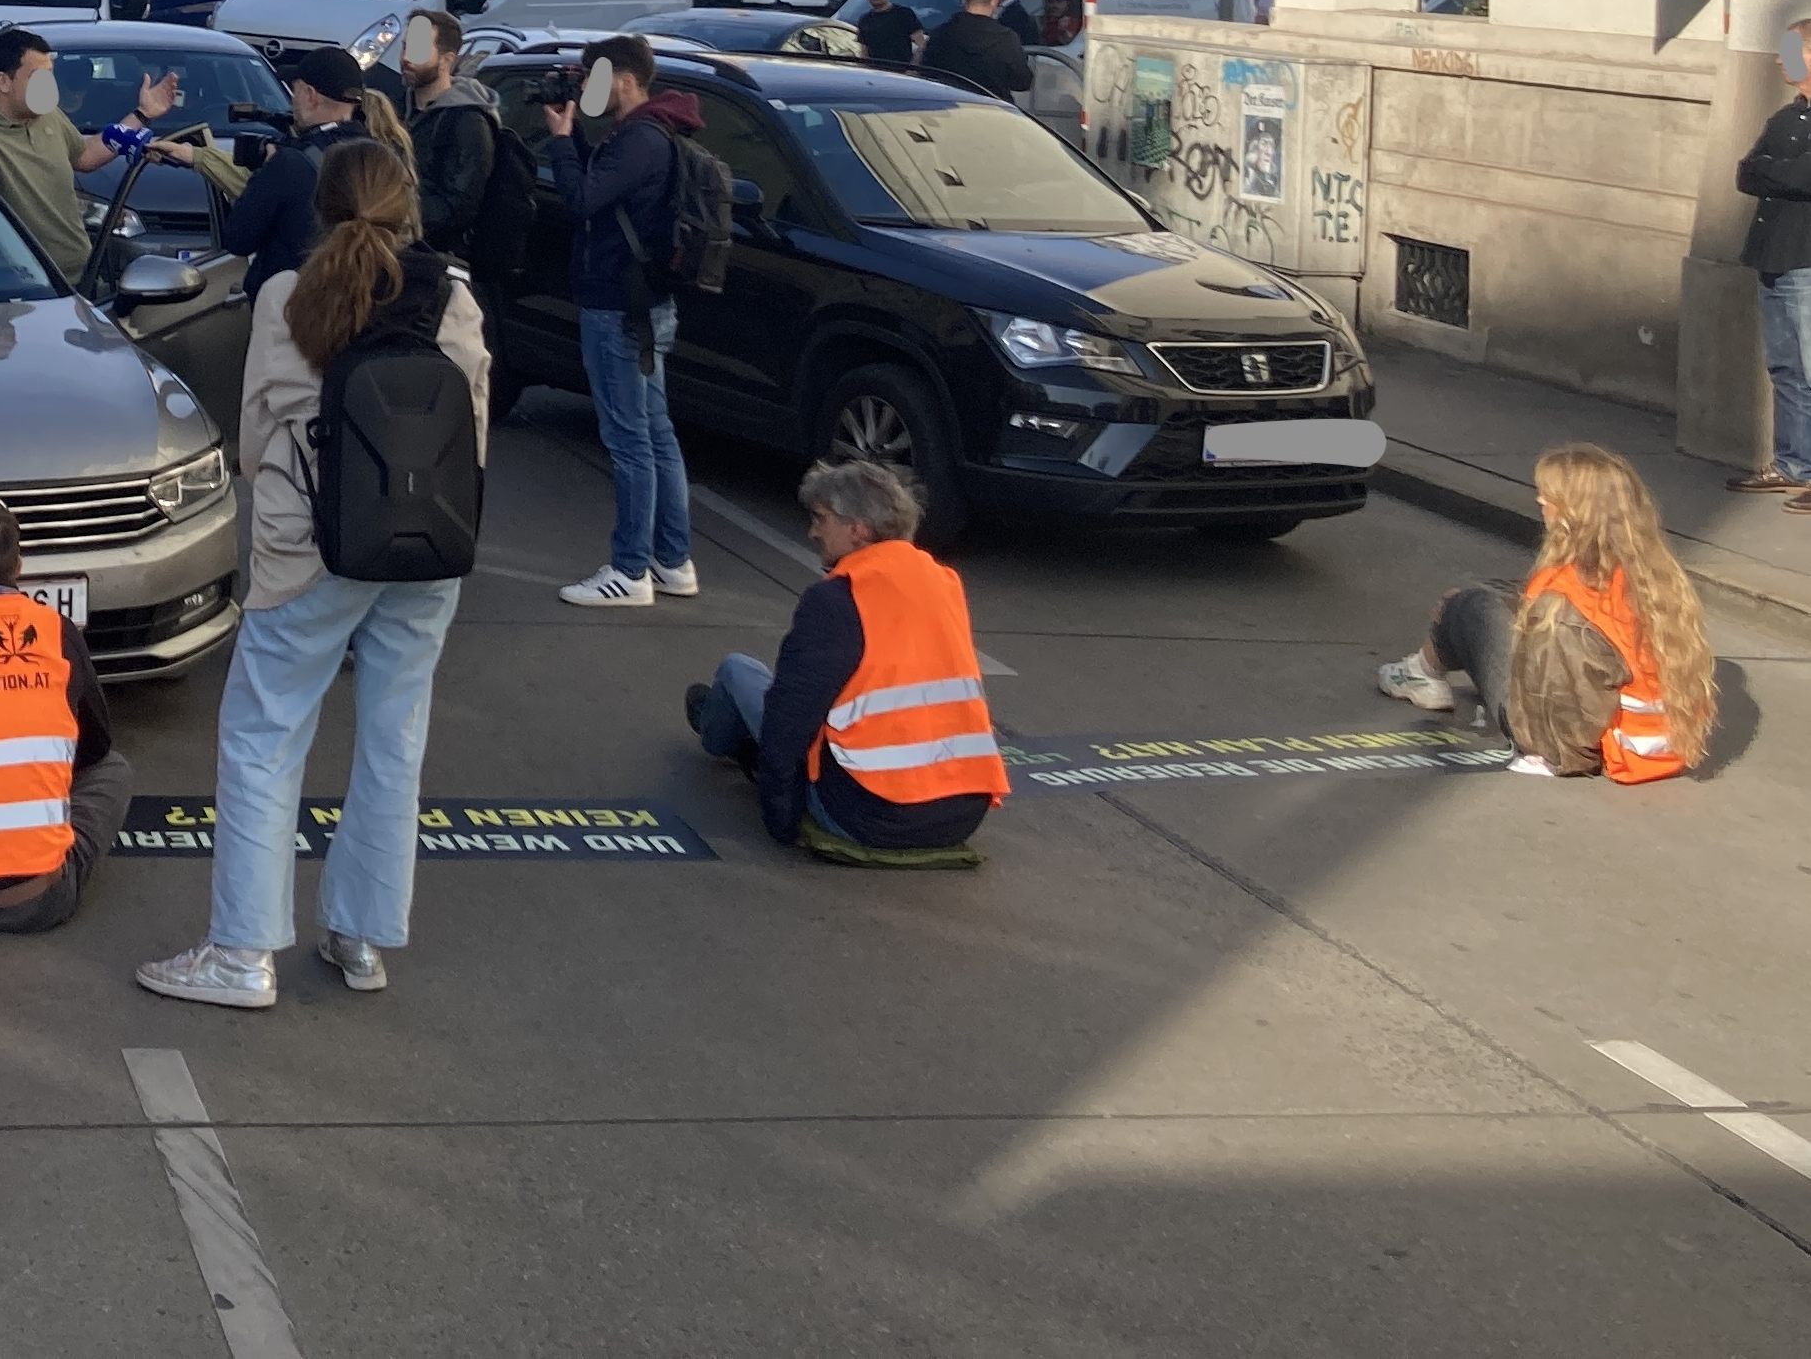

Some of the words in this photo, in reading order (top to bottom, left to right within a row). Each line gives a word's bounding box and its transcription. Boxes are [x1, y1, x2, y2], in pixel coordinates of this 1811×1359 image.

[1028, 760, 1260, 787] REGIERUNG
[463, 808, 661, 828] KEINEN
[419, 833, 573, 853] WENN
[582, 834, 687, 855] UND
